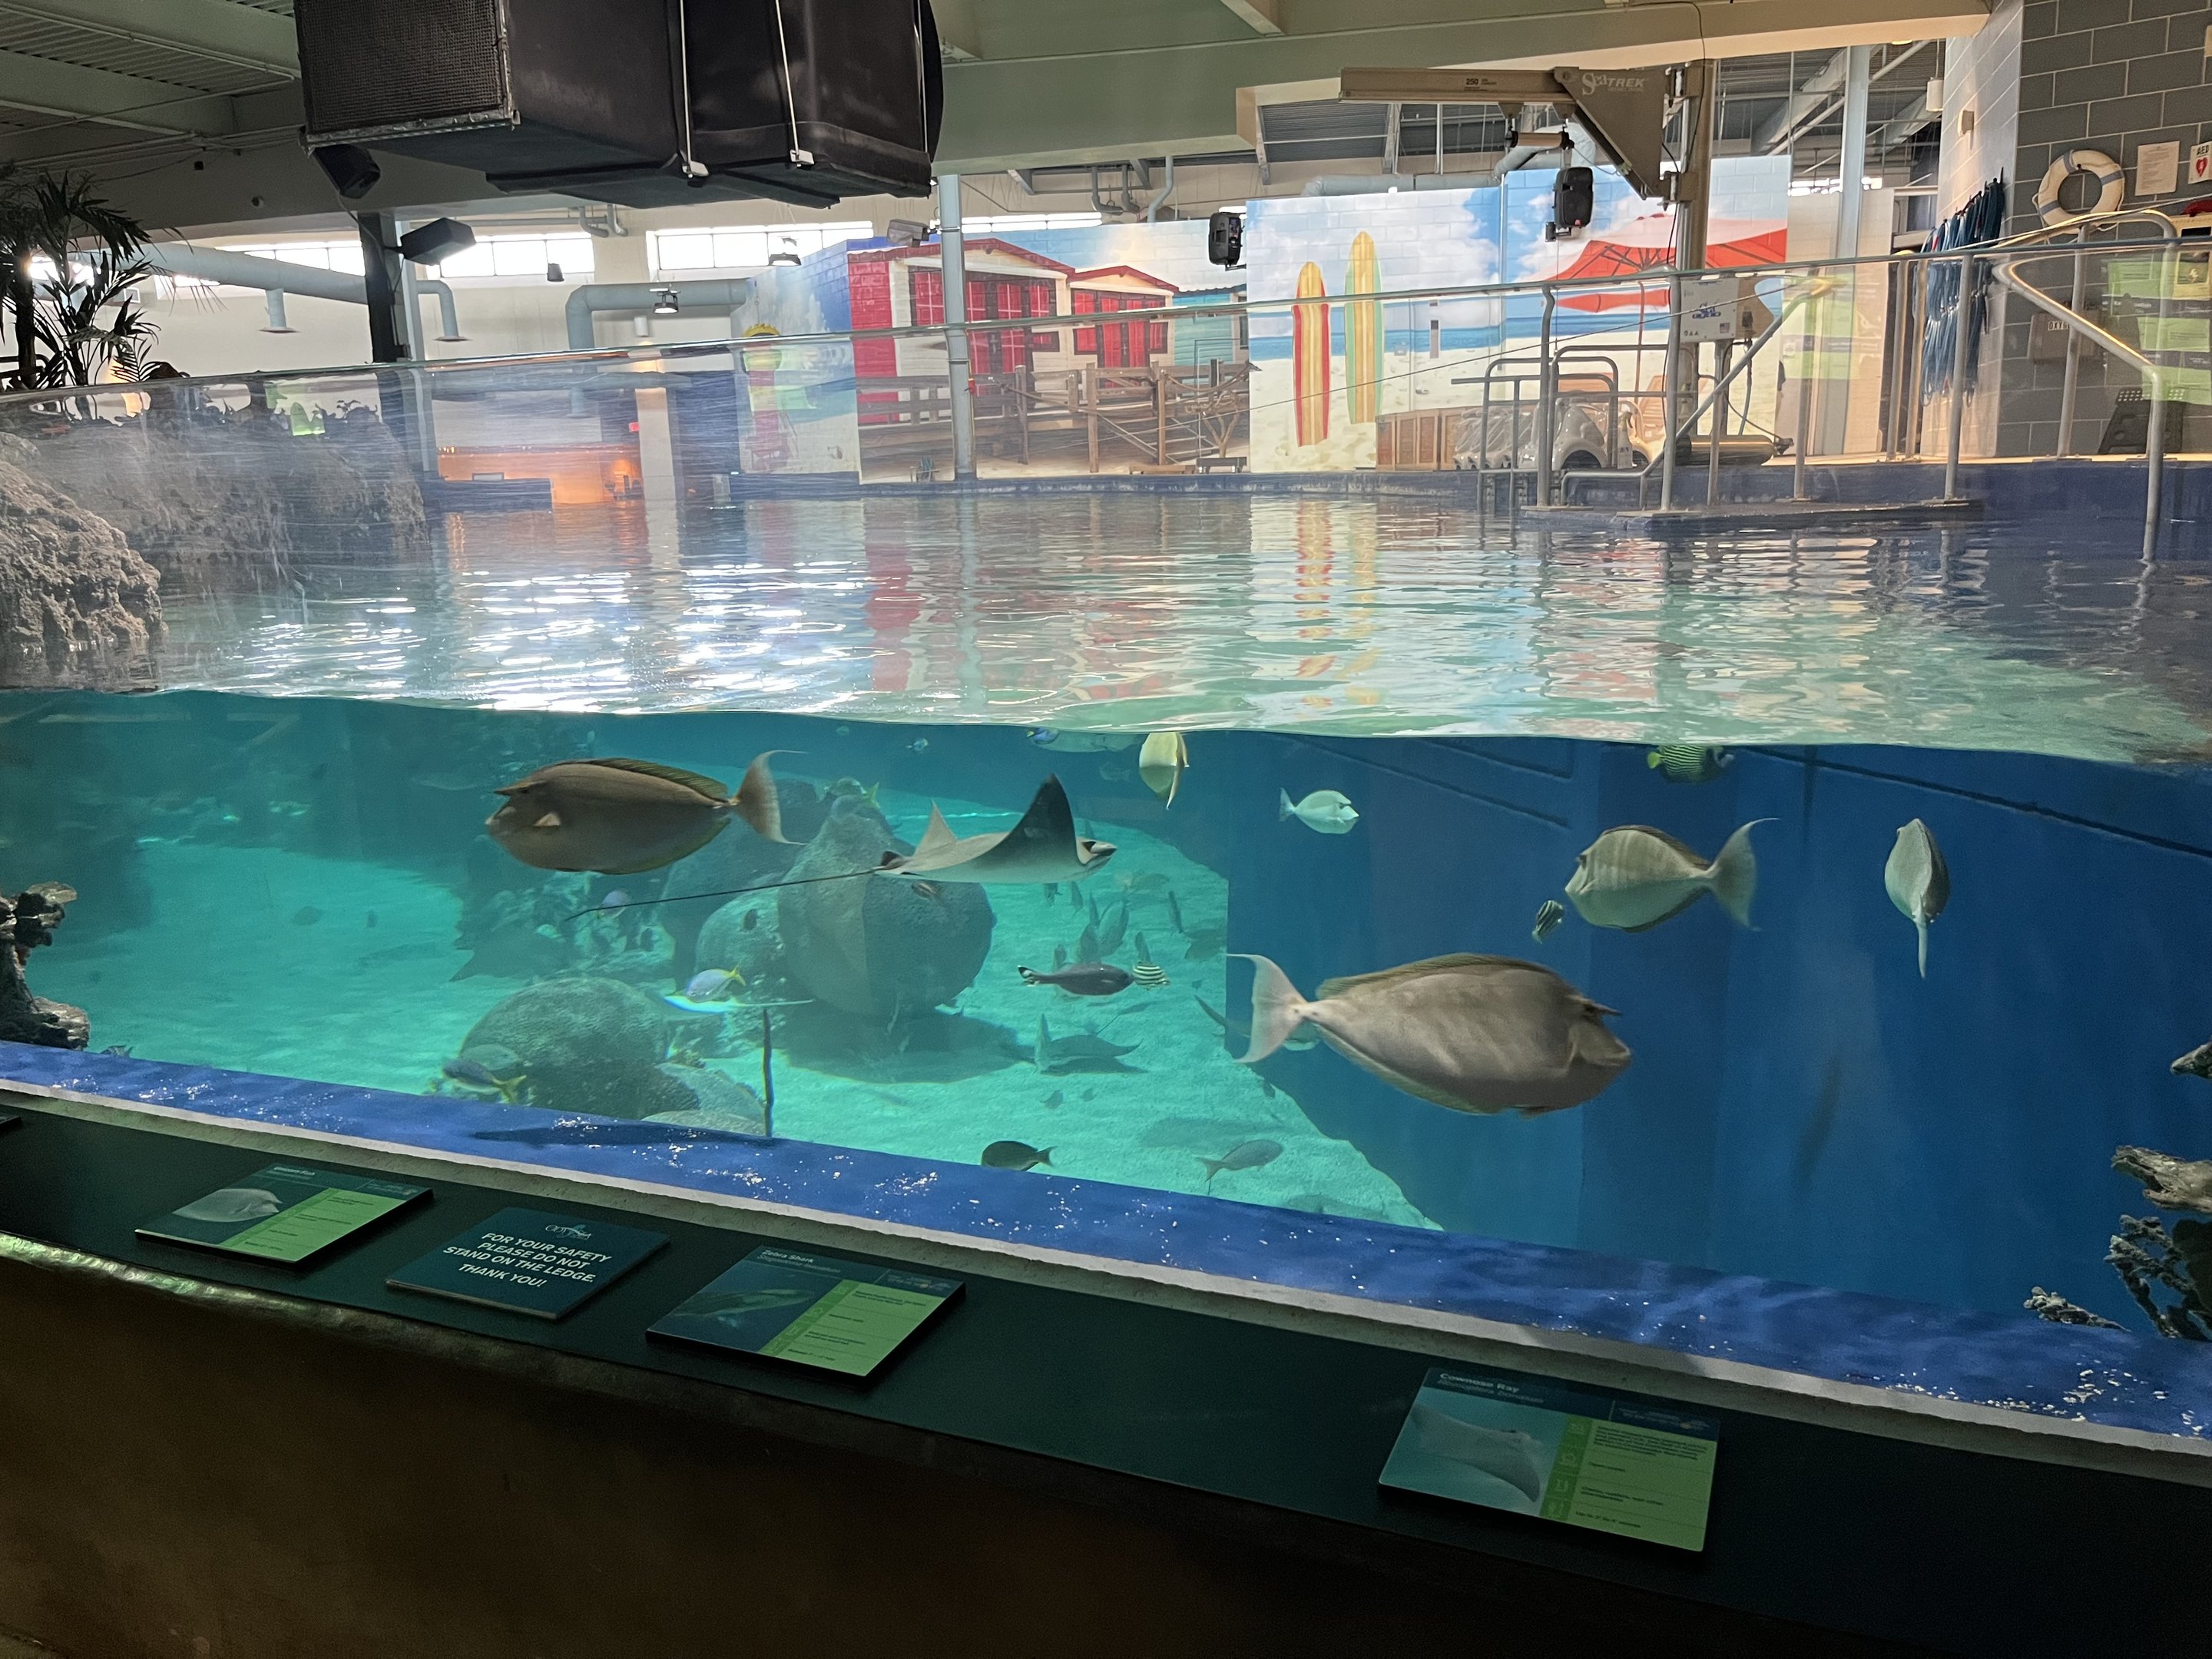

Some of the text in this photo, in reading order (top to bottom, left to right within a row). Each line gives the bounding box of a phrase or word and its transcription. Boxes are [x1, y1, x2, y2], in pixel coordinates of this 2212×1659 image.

[2197, 144, 2210, 155] AED
[477, 1242, 591, 1269] PLEASE DO NOT
[481, 1232, 613, 1263] FOR YOUR SAFETY
[762, 1250, 787, 1259] Zebra
[788, 1254, 814, 1263] Shark
[442, 1246, 597, 1283] STAND ON THE LEDGE.
[458, 1263, 548, 1287] THANK YOU!
[1496, 1382, 1520, 1393] Ray
